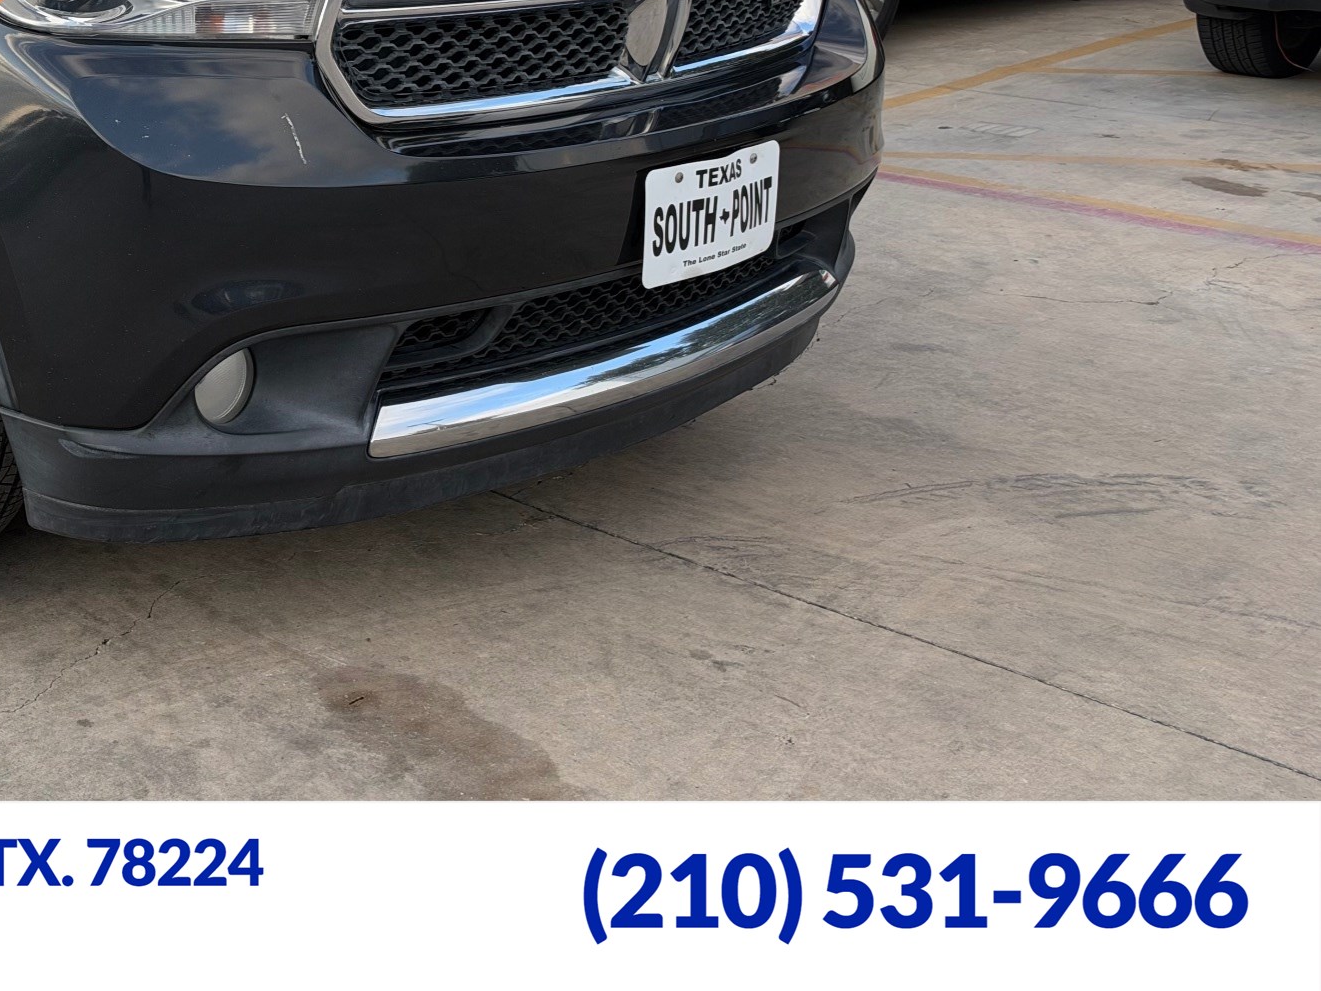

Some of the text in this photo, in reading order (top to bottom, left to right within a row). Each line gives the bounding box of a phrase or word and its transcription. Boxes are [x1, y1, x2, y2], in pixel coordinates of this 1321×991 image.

[695, 159, 742, 189] TEXAS
[652, 176, 773, 257] SOUTH POINT
[698, 254, 716, 264] Lone
[717, 248, 731, 258] Star
[731, 243, 747, 253] State
